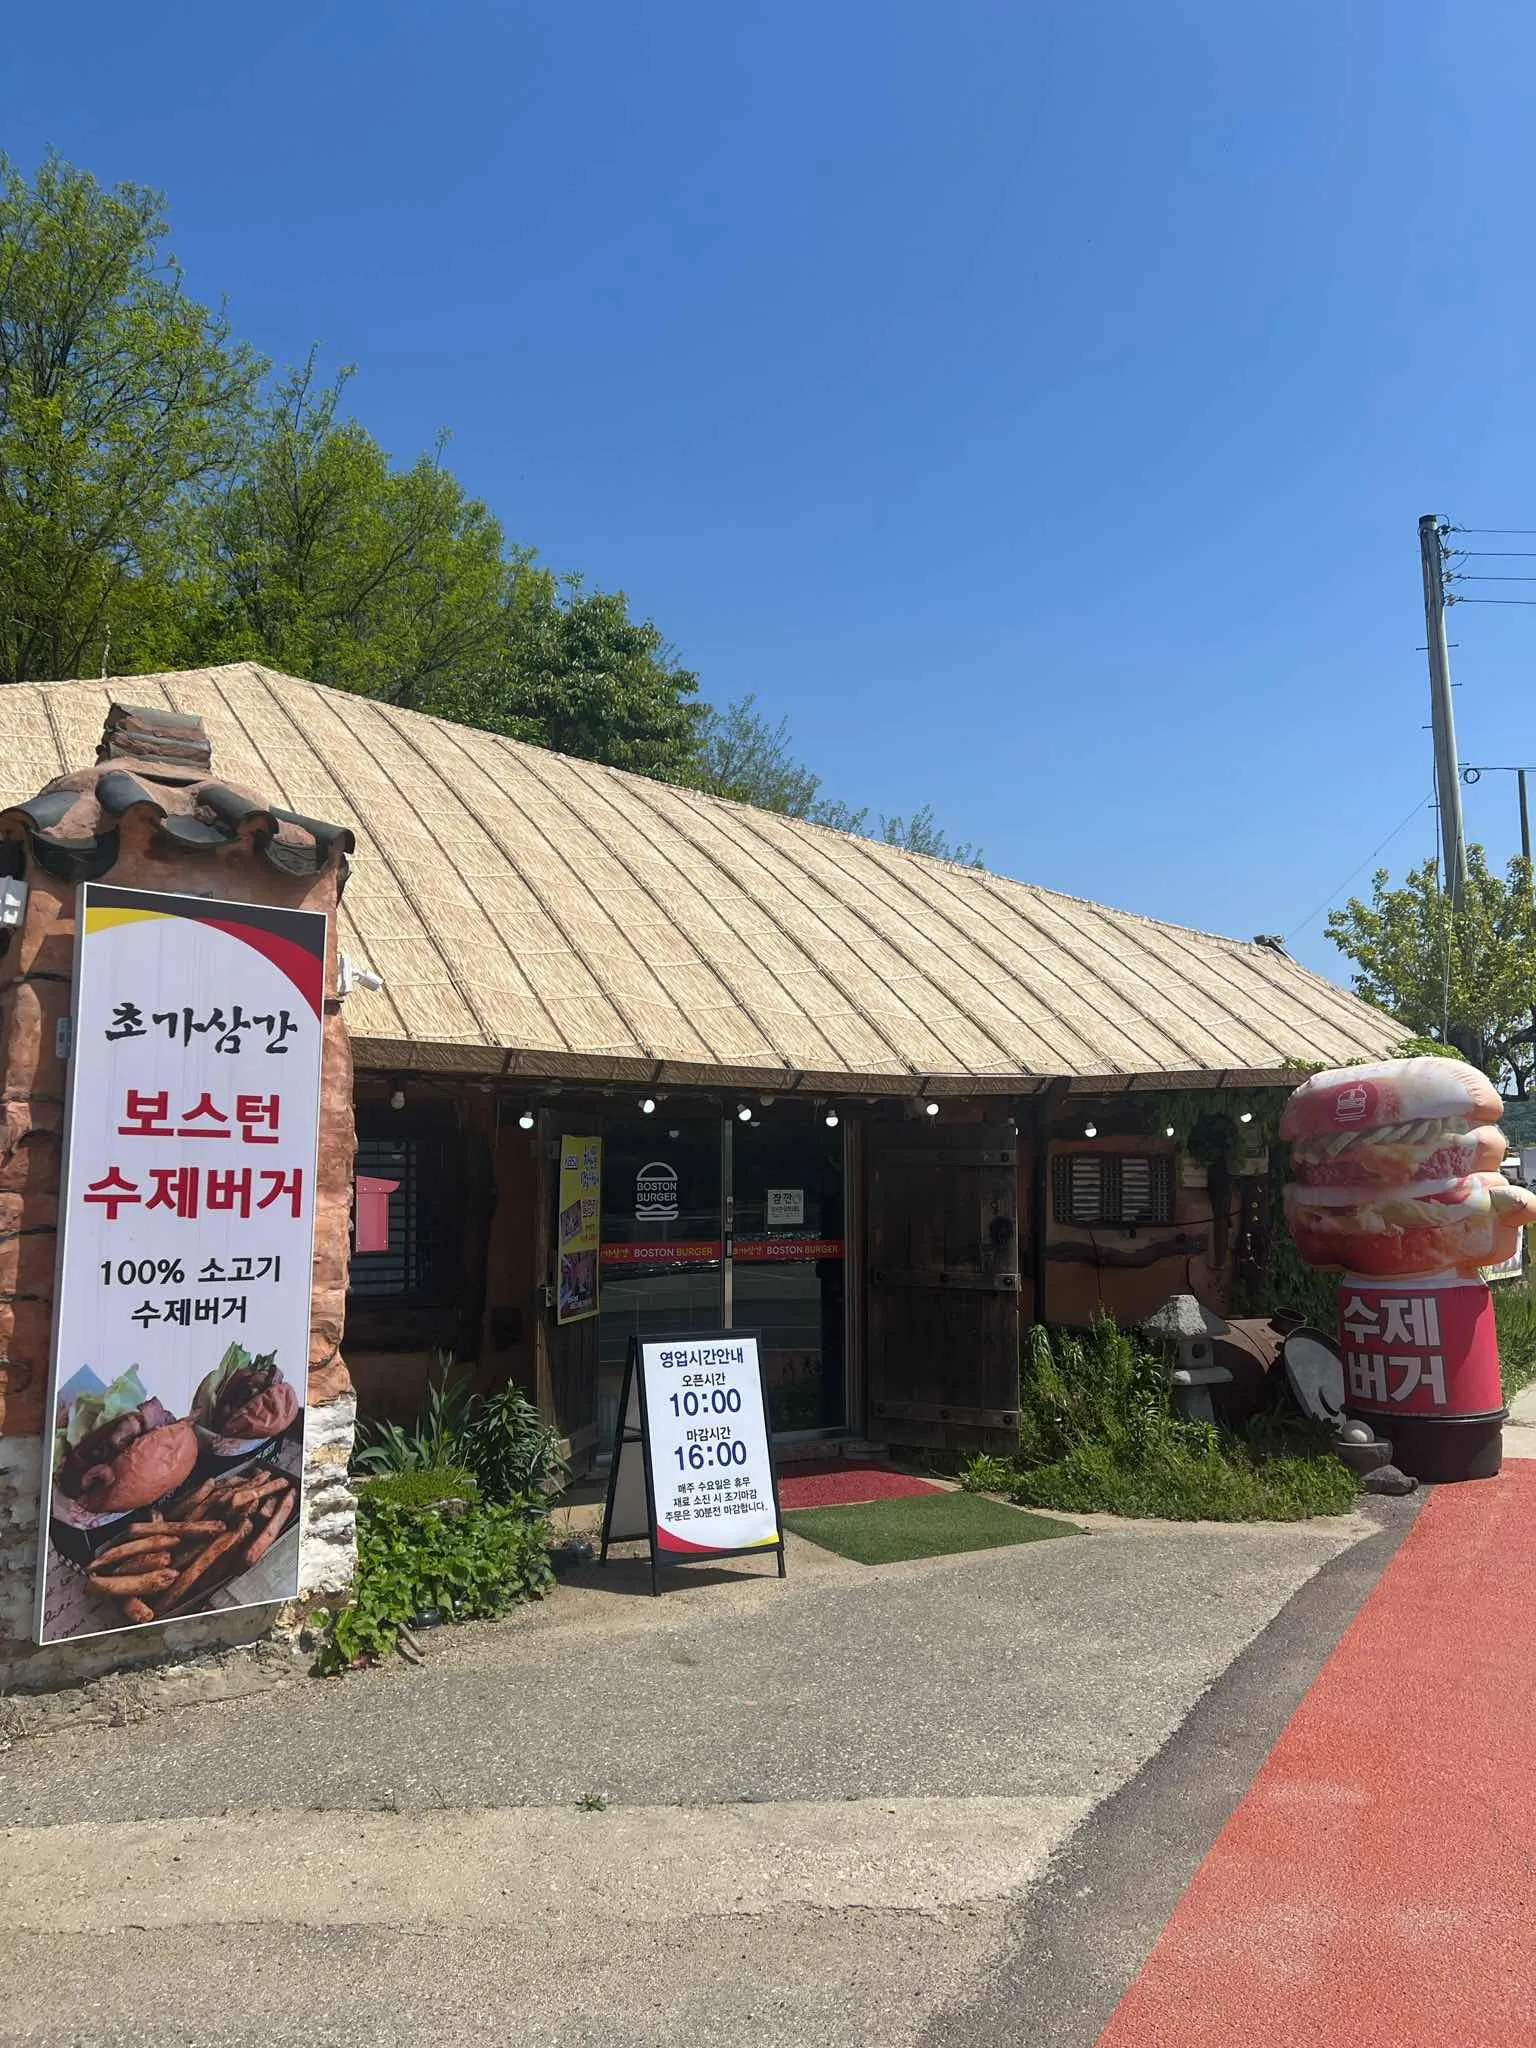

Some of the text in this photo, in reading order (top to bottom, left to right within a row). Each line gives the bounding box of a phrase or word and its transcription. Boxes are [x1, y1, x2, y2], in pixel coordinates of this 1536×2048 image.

[105, 1002, 298, 1054] 초가삼간
[118, 1090, 280, 1144] 보스턴
[84, 1167, 303, 1220] 수제버거
[637, 1182, 677, 1192] BOSTON
[637, 1192, 677, 1202] BURGER
[634, 1247, 674, 1258] BOSTON
[676, 1246, 713, 1257] BURGER
[766, 1245, 803, 1256] BOSTON
[804, 1244, 838, 1255] BURGER
[100, 1255, 281, 1286] 100% 소고기
[131, 1295, 247, 1329] 수제버거
[1343, 1296, 1440, 1346] 수제
[660, 1347, 744, 1368] 영업시간안내
[682, 1372, 726, 1387] 오픈시간
[1347, 1352, 1448, 1405] 버거
[670, 1388, 741, 1416] 10:00
[686, 1426, 731, 1442] 마감시간
[674, 1440, 747, 1471] 16:00
[678, 1477, 751, 1494] 매주 수요일은 휴무
[673, 1489, 757, 1507] 재료 소진 시 조기마감
[665, 1501, 768, 1522] 주문은 30분전 마감합니다.
